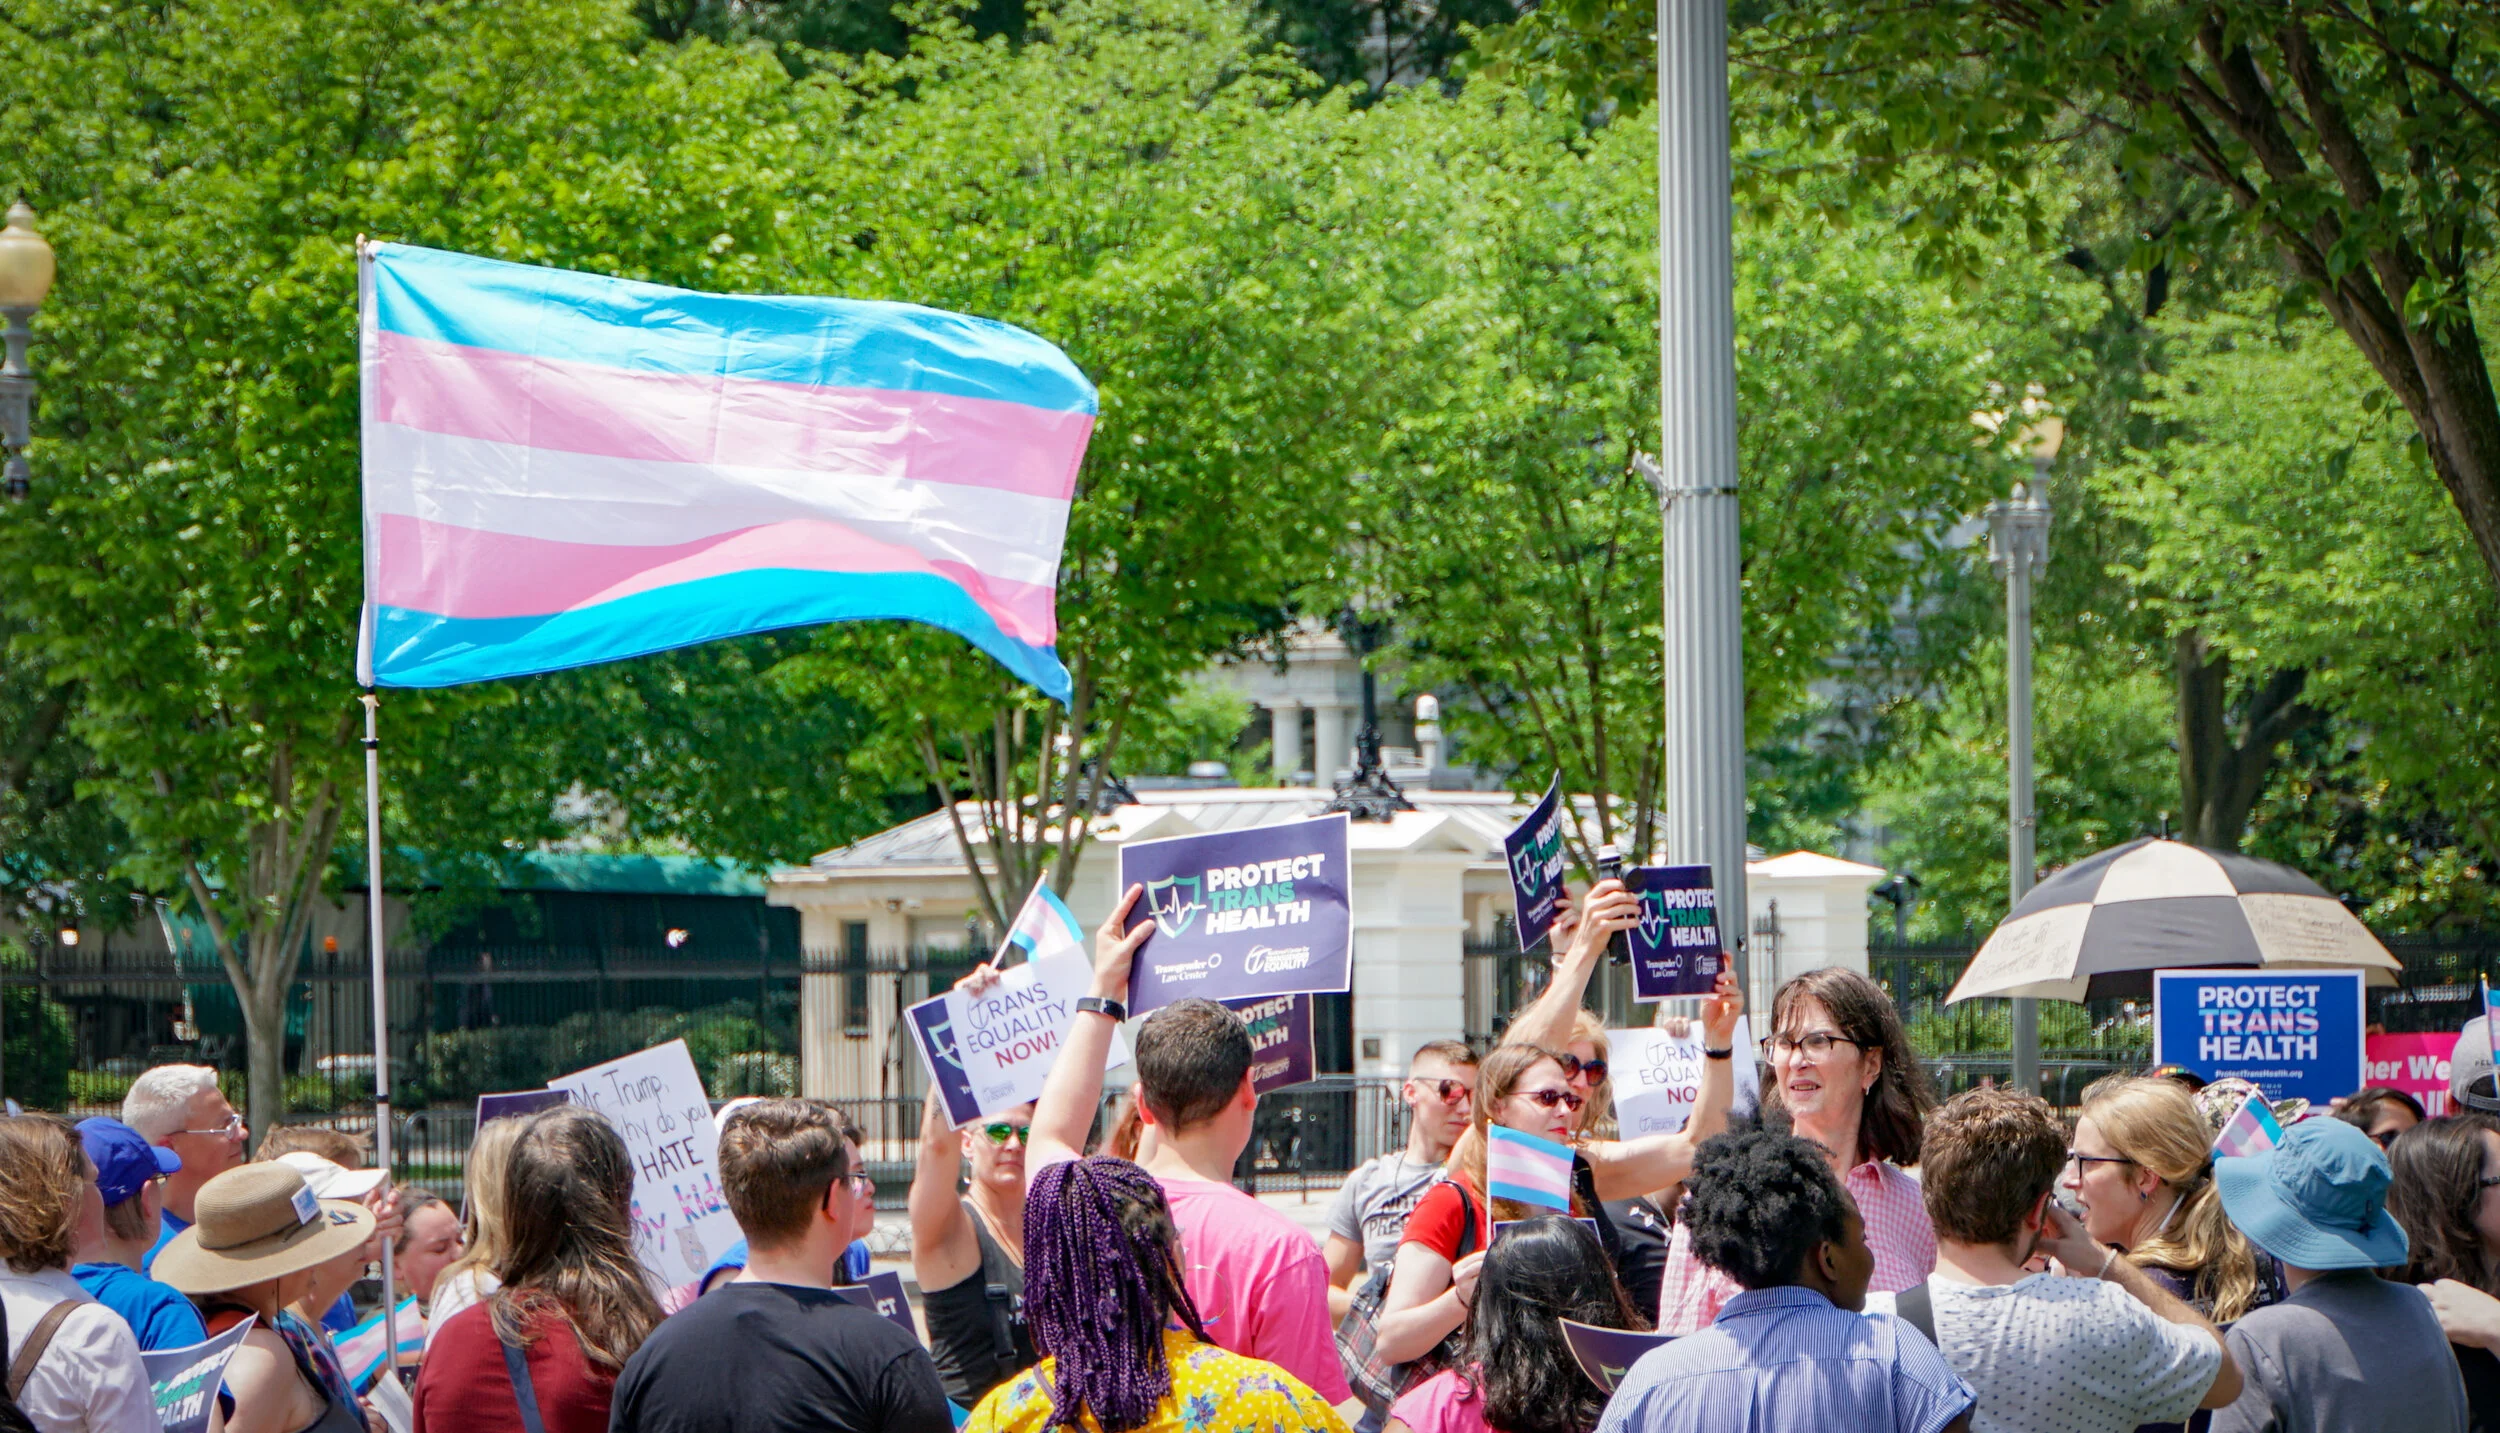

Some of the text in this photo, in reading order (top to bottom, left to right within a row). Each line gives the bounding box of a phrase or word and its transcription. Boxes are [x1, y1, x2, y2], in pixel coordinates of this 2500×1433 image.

[1207, 853, 1325, 892] PROTECT
[1208, 881, 1296, 913] TRANS
[1205, 900, 1310, 935] HEALTH
[1668, 908, 1710, 927] TRANS
[1670, 926, 1717, 947] HEALTH
[967, 982, 1048, 1029] TRANS
[1234, 994, 1296, 1024] OTECT
[2198, 985, 2320, 1008] PROTECT
[967, 998, 1066, 1054] EQUALITY
[2198, 1007, 2319, 1036] TRANS
[994, 1030, 1059, 1069] NOW!
[1646, 1041, 1706, 1066] TRAN
[2199, 1035, 2318, 1061] HEALTH
[2215, 1069, 2303, 1079] ProtectTransHealth.org
[2366, 1055, 2451, 1080] her We
[1667, 1086, 1699, 1105] NO
[619, 1102, 706, 1147] hy do you
[639, 1136, 704, 1184] HATE
